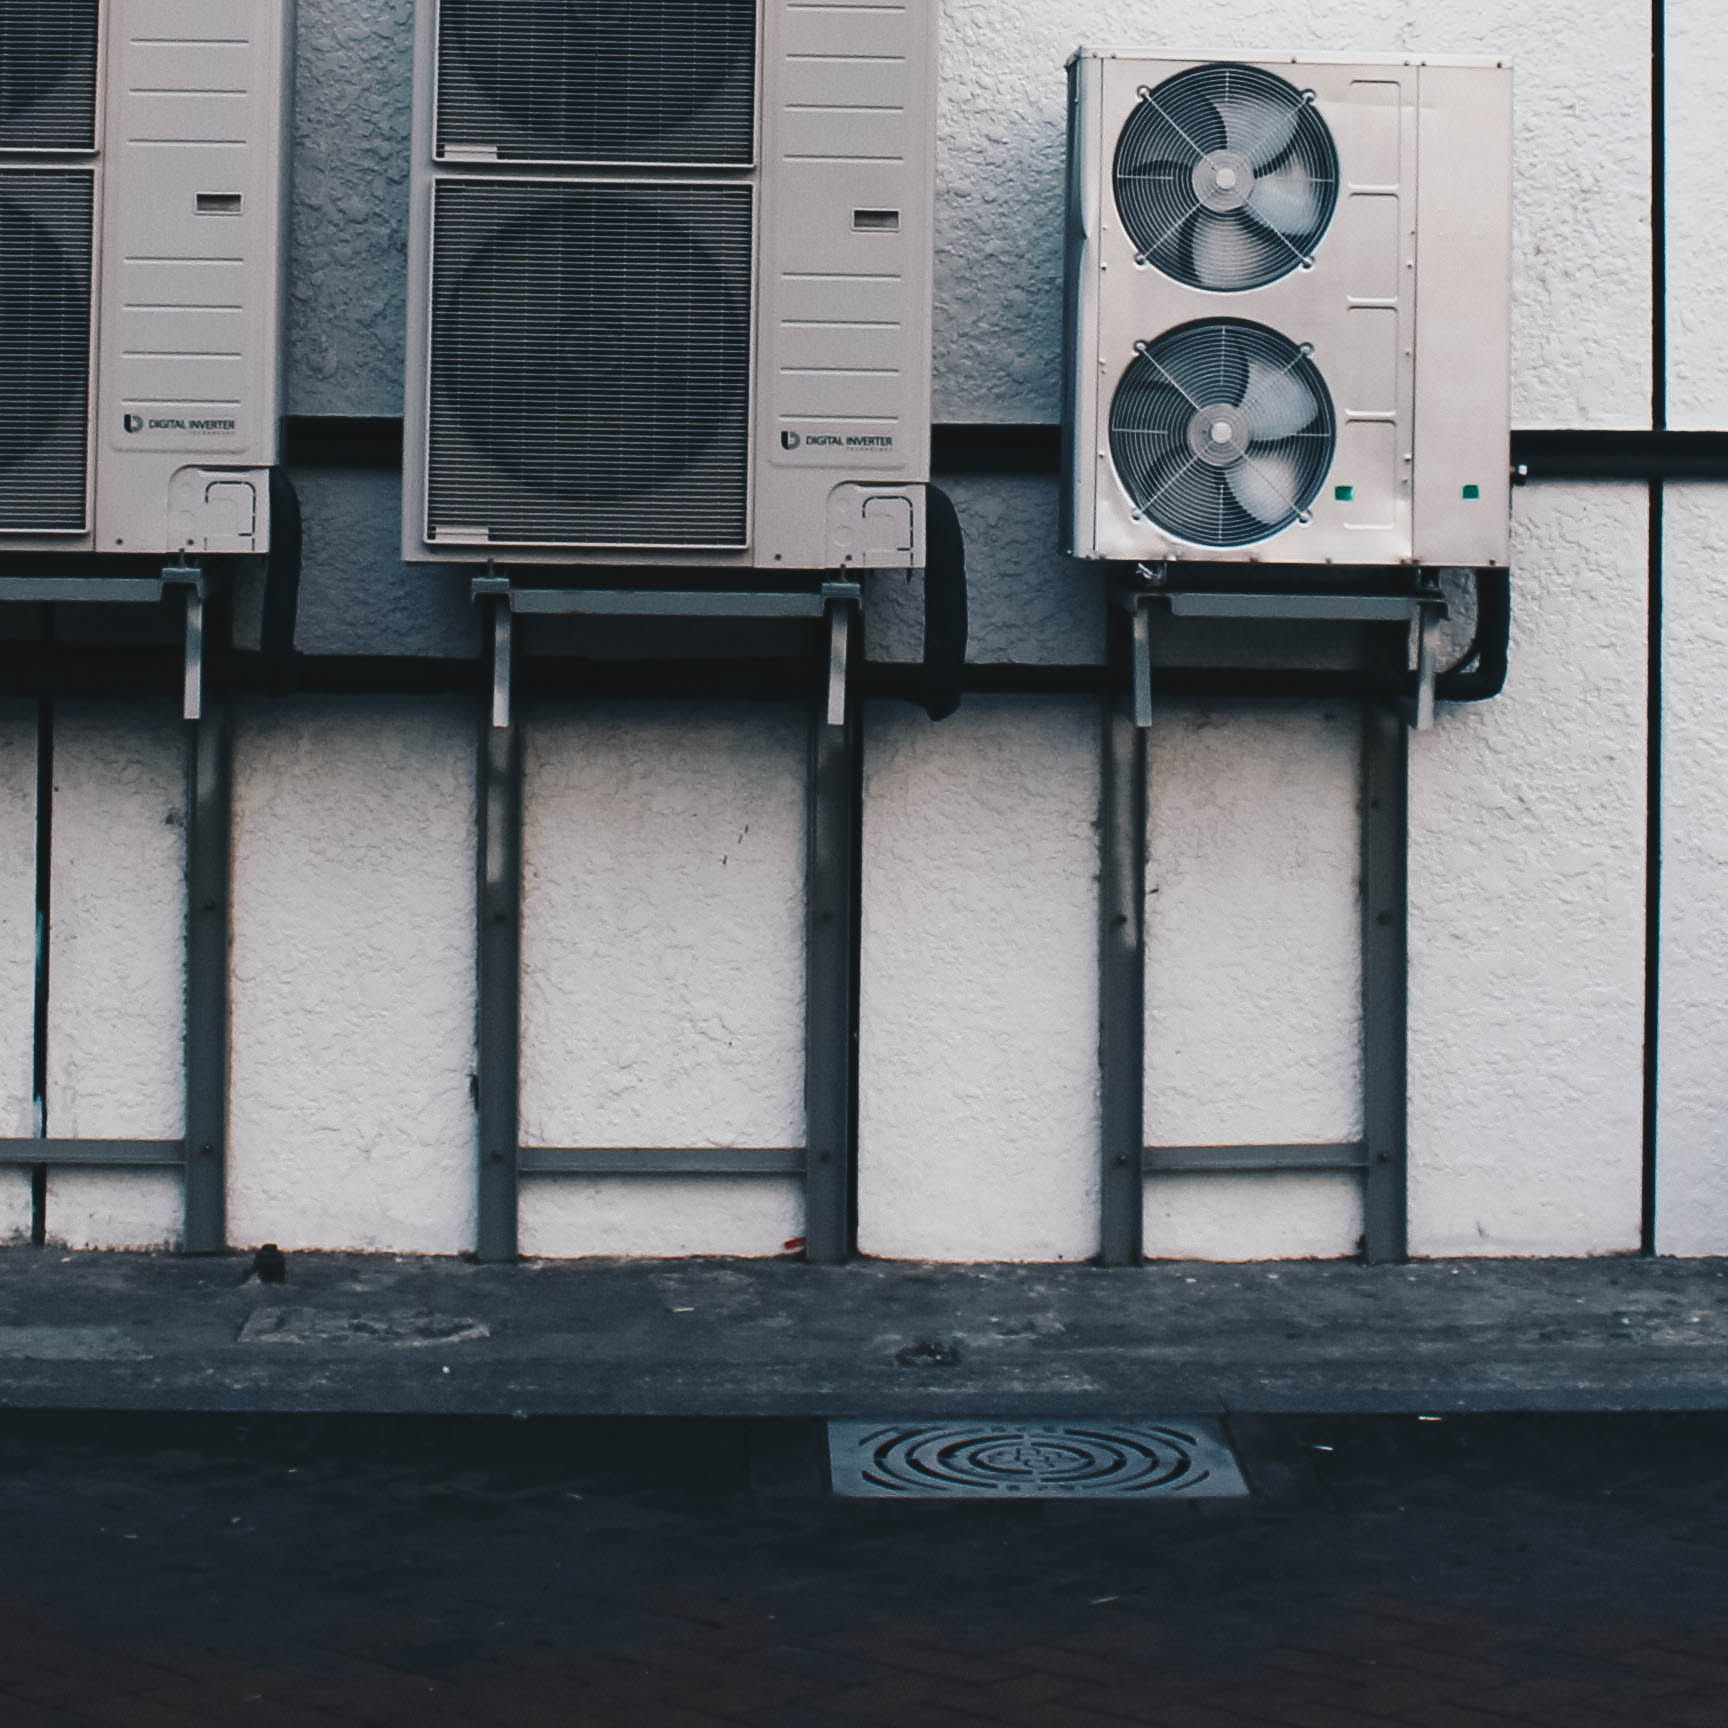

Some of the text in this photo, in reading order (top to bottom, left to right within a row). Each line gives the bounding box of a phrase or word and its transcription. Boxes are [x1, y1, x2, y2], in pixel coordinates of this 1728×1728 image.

[148, 418, 235, 430] DIGITAL INVERTER
[805, 435, 893, 447] DIGITAL INVERTER
